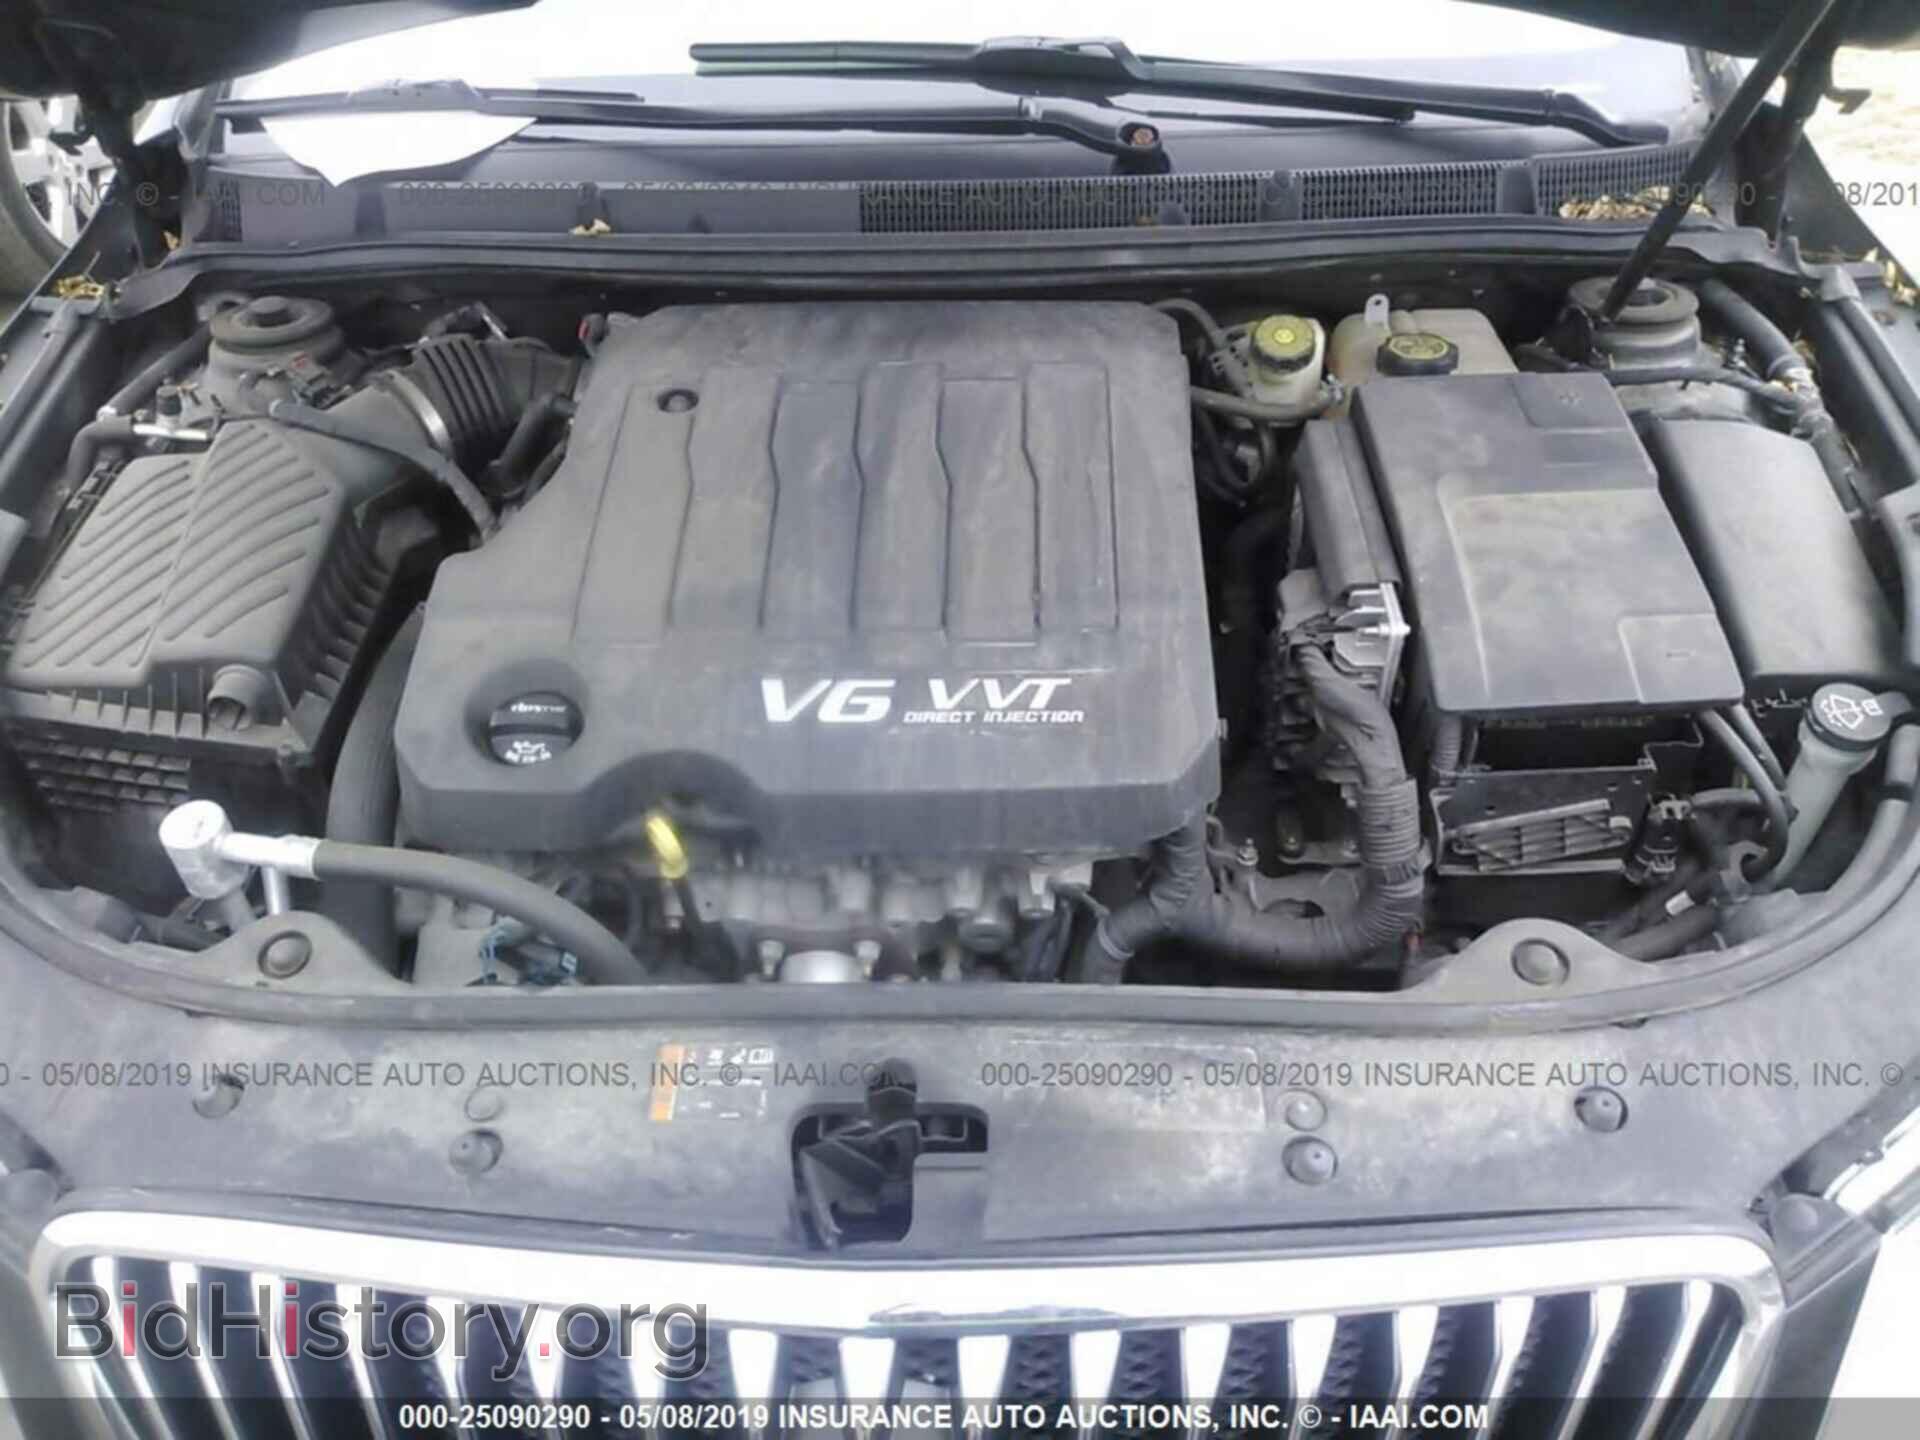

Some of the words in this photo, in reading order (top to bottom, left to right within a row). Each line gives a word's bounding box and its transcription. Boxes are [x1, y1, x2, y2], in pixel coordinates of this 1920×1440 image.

[761, 678, 897, 723] V6
[927, 677, 1073, 710] VVT
[903, 710, 975, 724] DIRECT
[983, 710, 1085, 724] INJECTION
